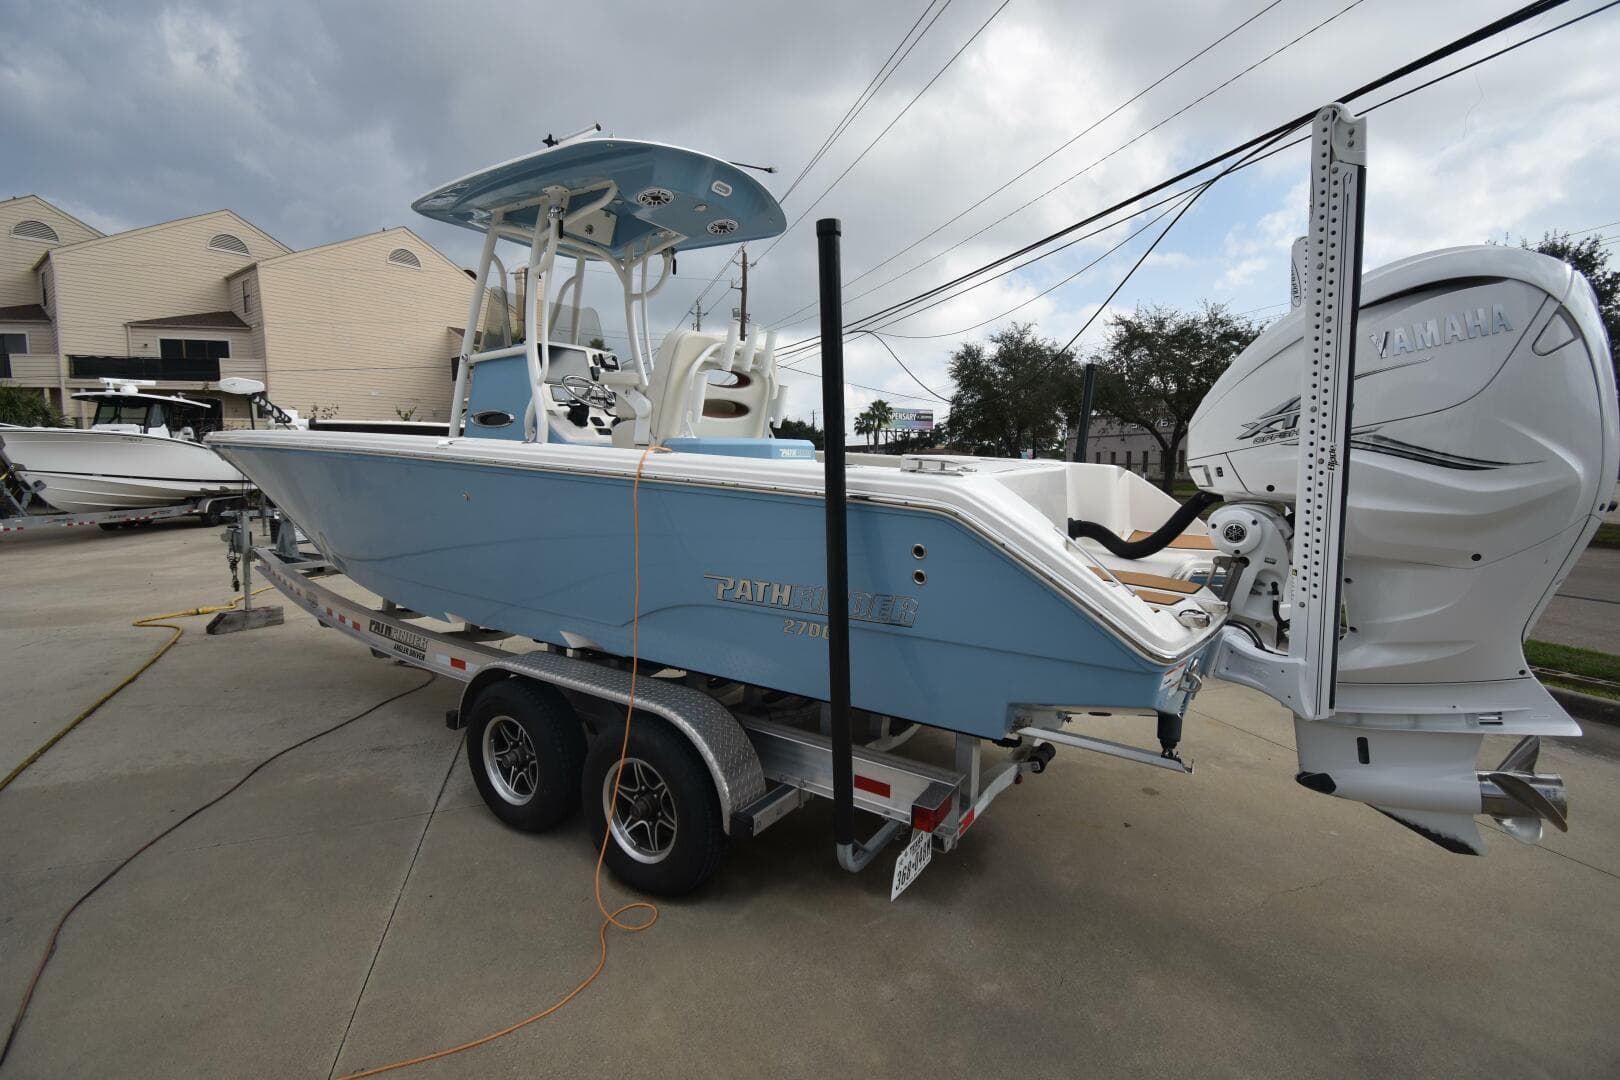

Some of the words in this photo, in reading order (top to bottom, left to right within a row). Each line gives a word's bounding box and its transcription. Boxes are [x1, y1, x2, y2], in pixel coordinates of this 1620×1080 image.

[1369, 303, 1514, 360] YAMAHA
[1253, 429, 1300, 444] OFFSH
[704, 574, 919, 628] PATHFIDER
